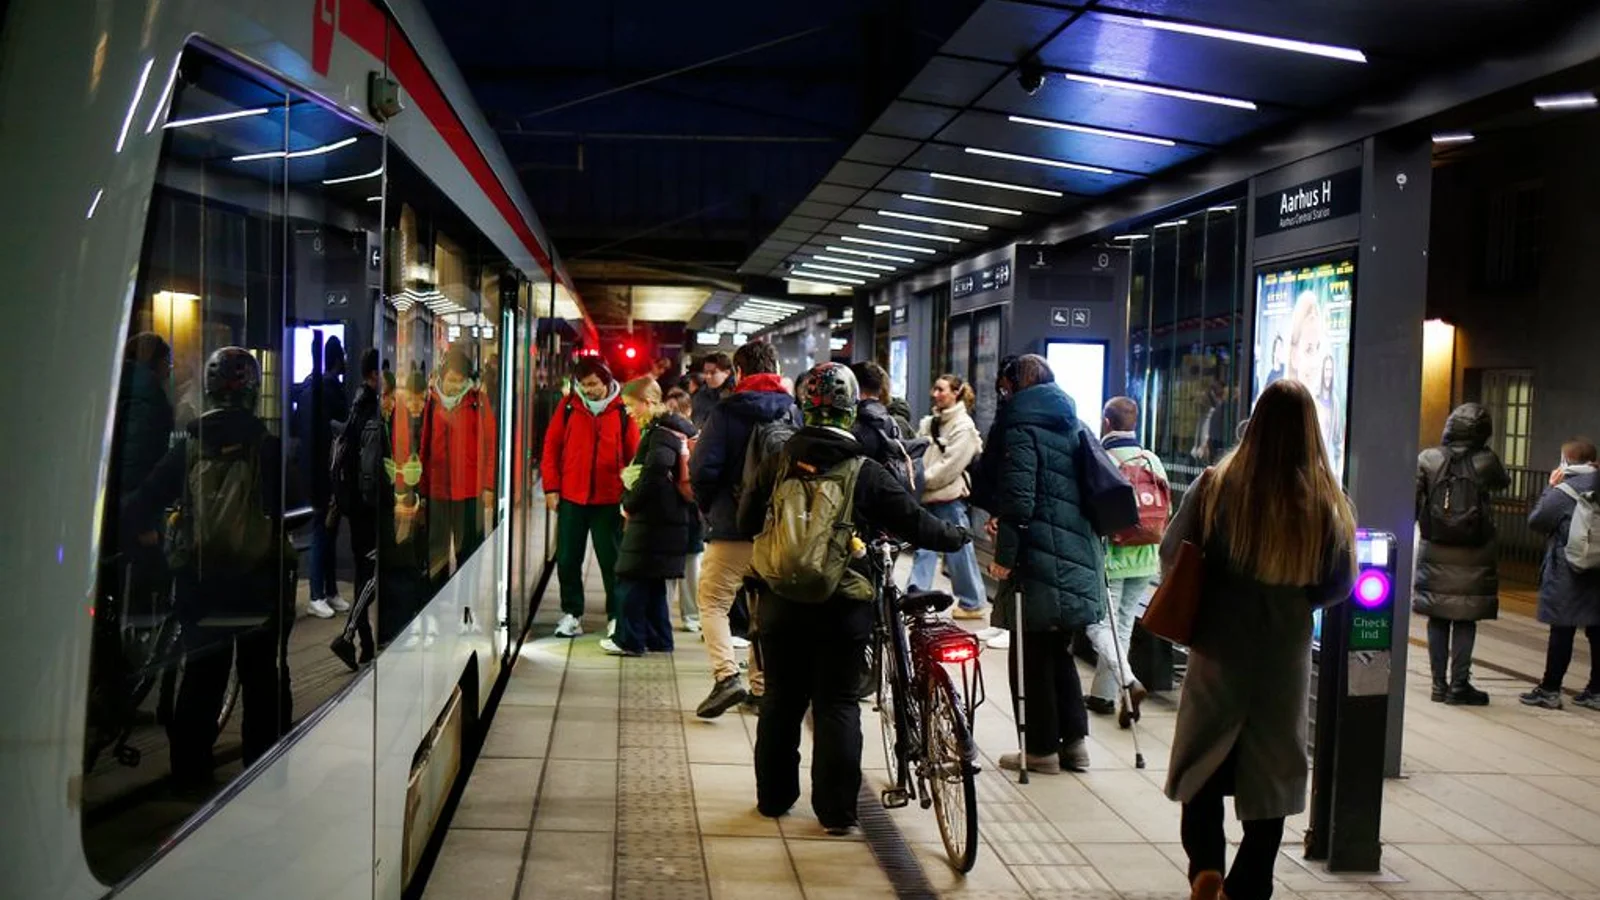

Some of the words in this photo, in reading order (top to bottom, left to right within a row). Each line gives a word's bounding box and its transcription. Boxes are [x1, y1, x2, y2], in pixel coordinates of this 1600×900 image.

[1280, 188, 1319, 215] Aarhus
[1322, 180, 1331, 203] H
[1036, 252, 1045, 265] 1
[1353, 617, 1388, 628] Check
